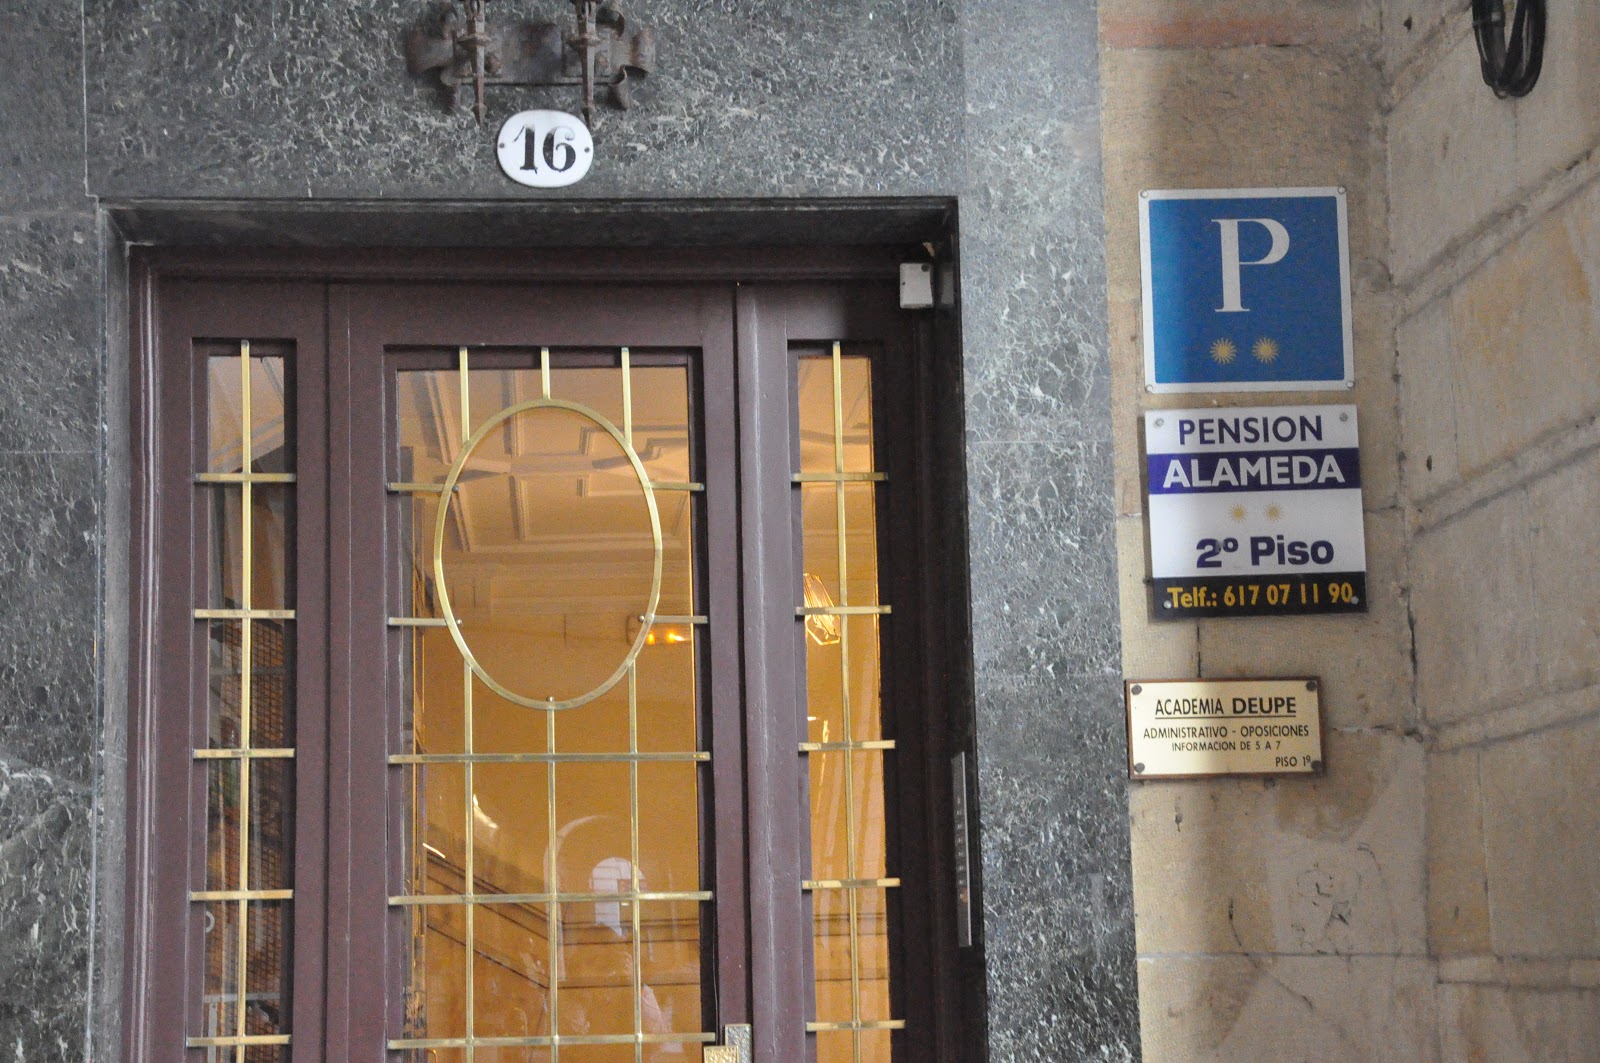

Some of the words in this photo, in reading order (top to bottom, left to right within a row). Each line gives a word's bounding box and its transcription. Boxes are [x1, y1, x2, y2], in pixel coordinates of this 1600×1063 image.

[513, 125, 576, 174] 16
[1211, 218, 1290, 313] P
[1178, 415, 1323, 446] PENSION
[1163, 454, 1346, 489] ALAMEDA
[1250, 535, 1335, 566] Piso
[1224, 584, 1260, 606] 617
[1266, 584, 1291, 605] 07
[1300, 583, 1318, 604] 11
[1328, 582, 1353, 604] 90
[1155, 698, 1224, 716] ACADEMIA
[1232, 697, 1297, 715] DEUPE
[1143, 726, 1228, 739] ADMINISTRATIVO
[1240, 725, 1309, 737] OPOSICIONES
[1171, 741, 1236, 752] INFORMACION
[1240, 741, 1251, 750] DE
[1255, 741, 1261, 750] 5
[1265, 741, 1272, 750] A
[1275, 740, 1281, 750] 7
[1275, 756, 1298, 767] PISO
